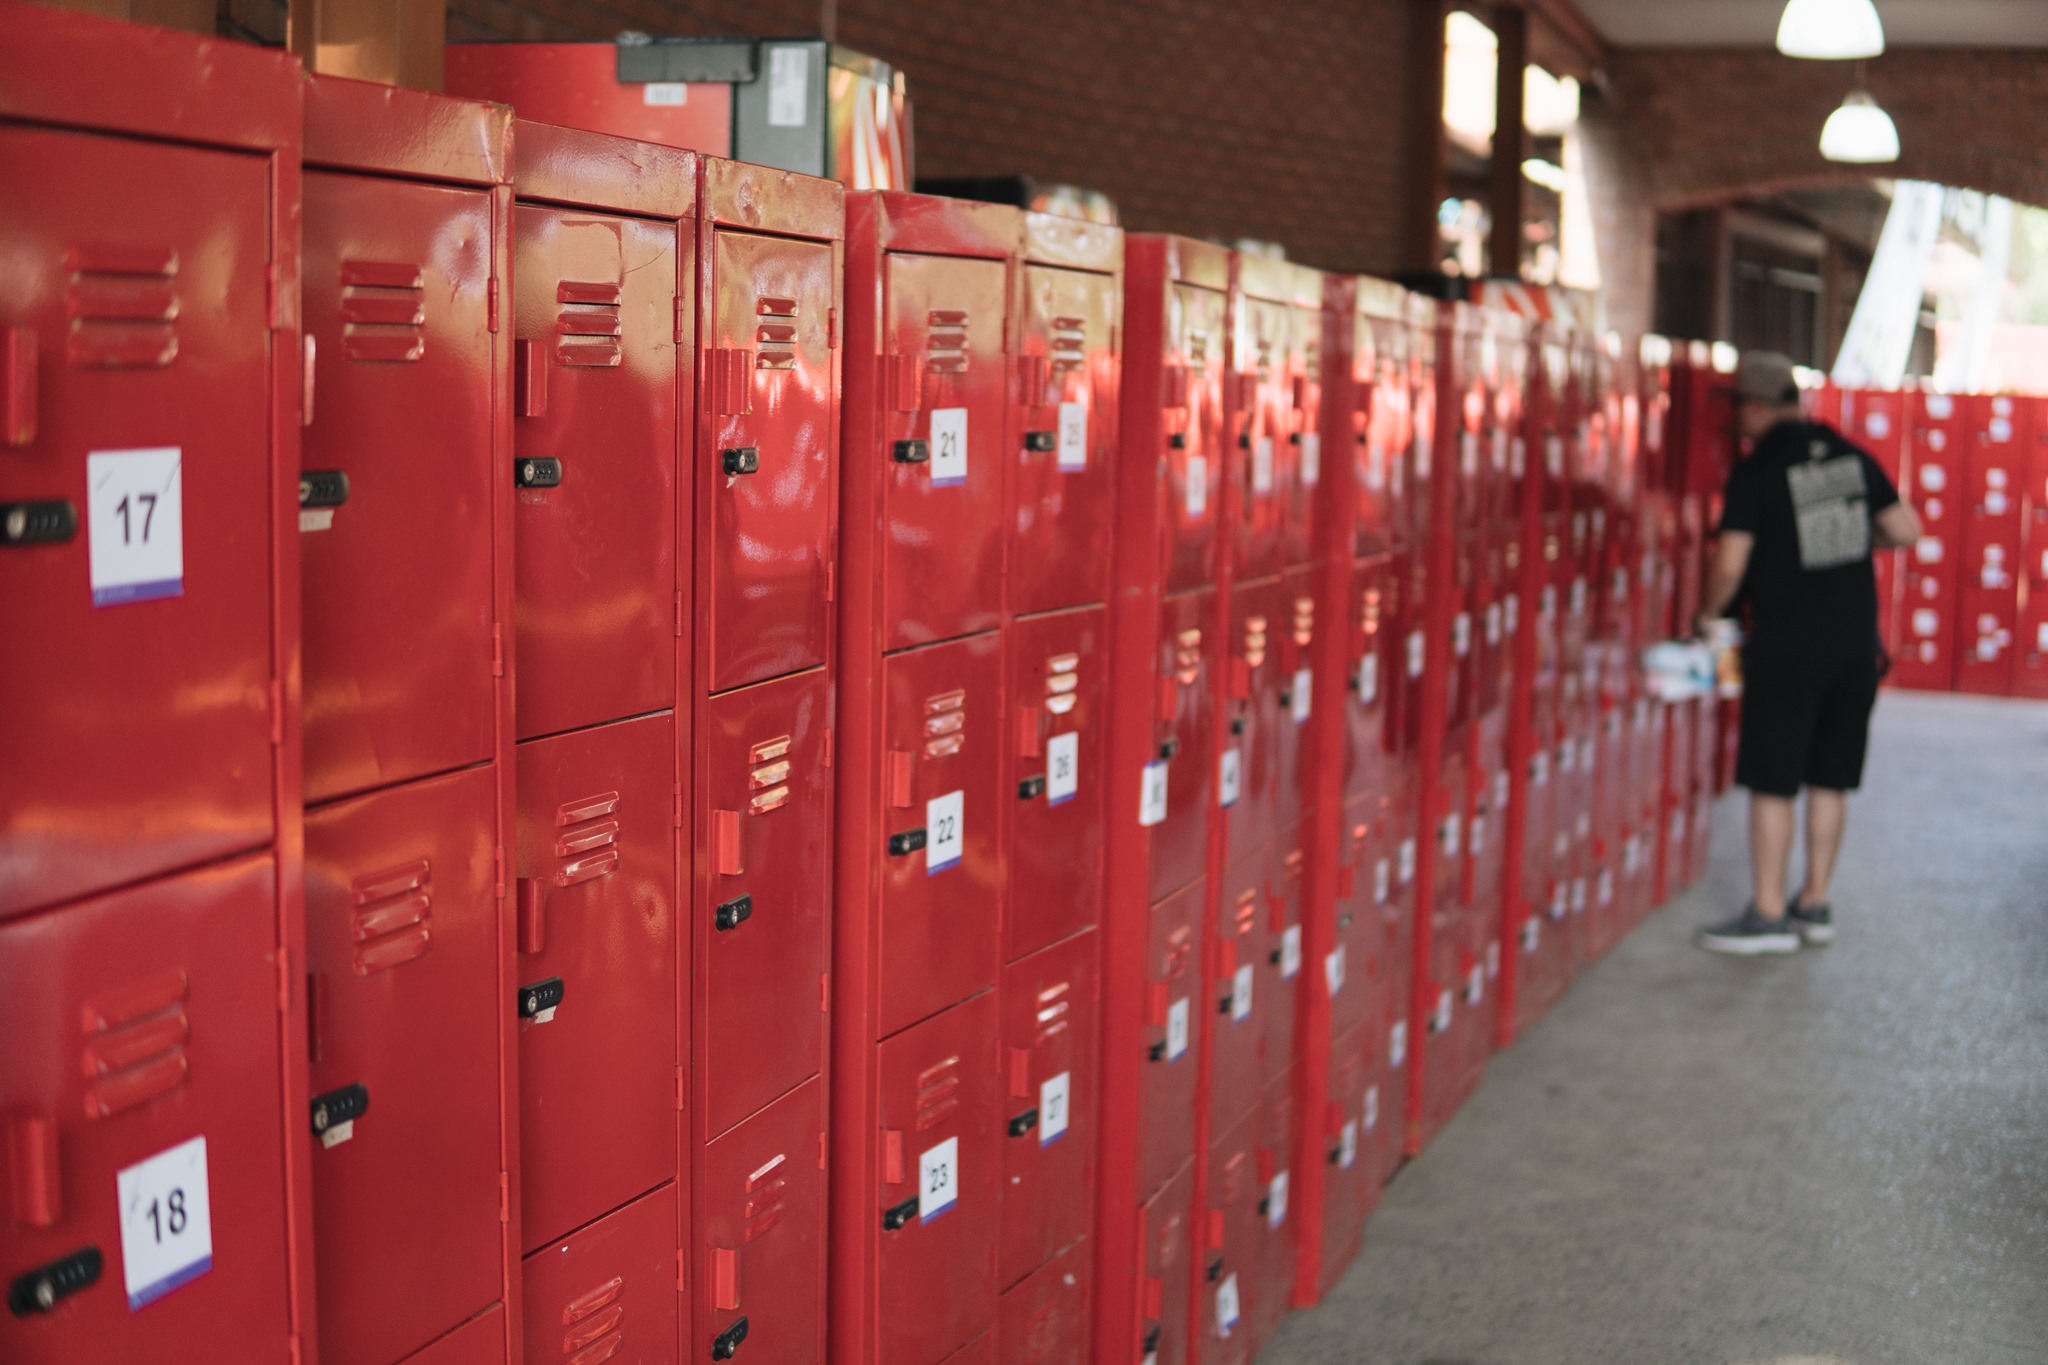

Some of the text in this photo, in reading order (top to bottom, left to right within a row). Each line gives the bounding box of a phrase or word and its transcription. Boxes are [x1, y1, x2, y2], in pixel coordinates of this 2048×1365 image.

[940, 431, 957, 458] 21
[116, 493, 157, 546] 17
[937, 815, 954, 845] 22
[930, 1162, 948, 1194] 23
[147, 1187, 187, 1243] 18
